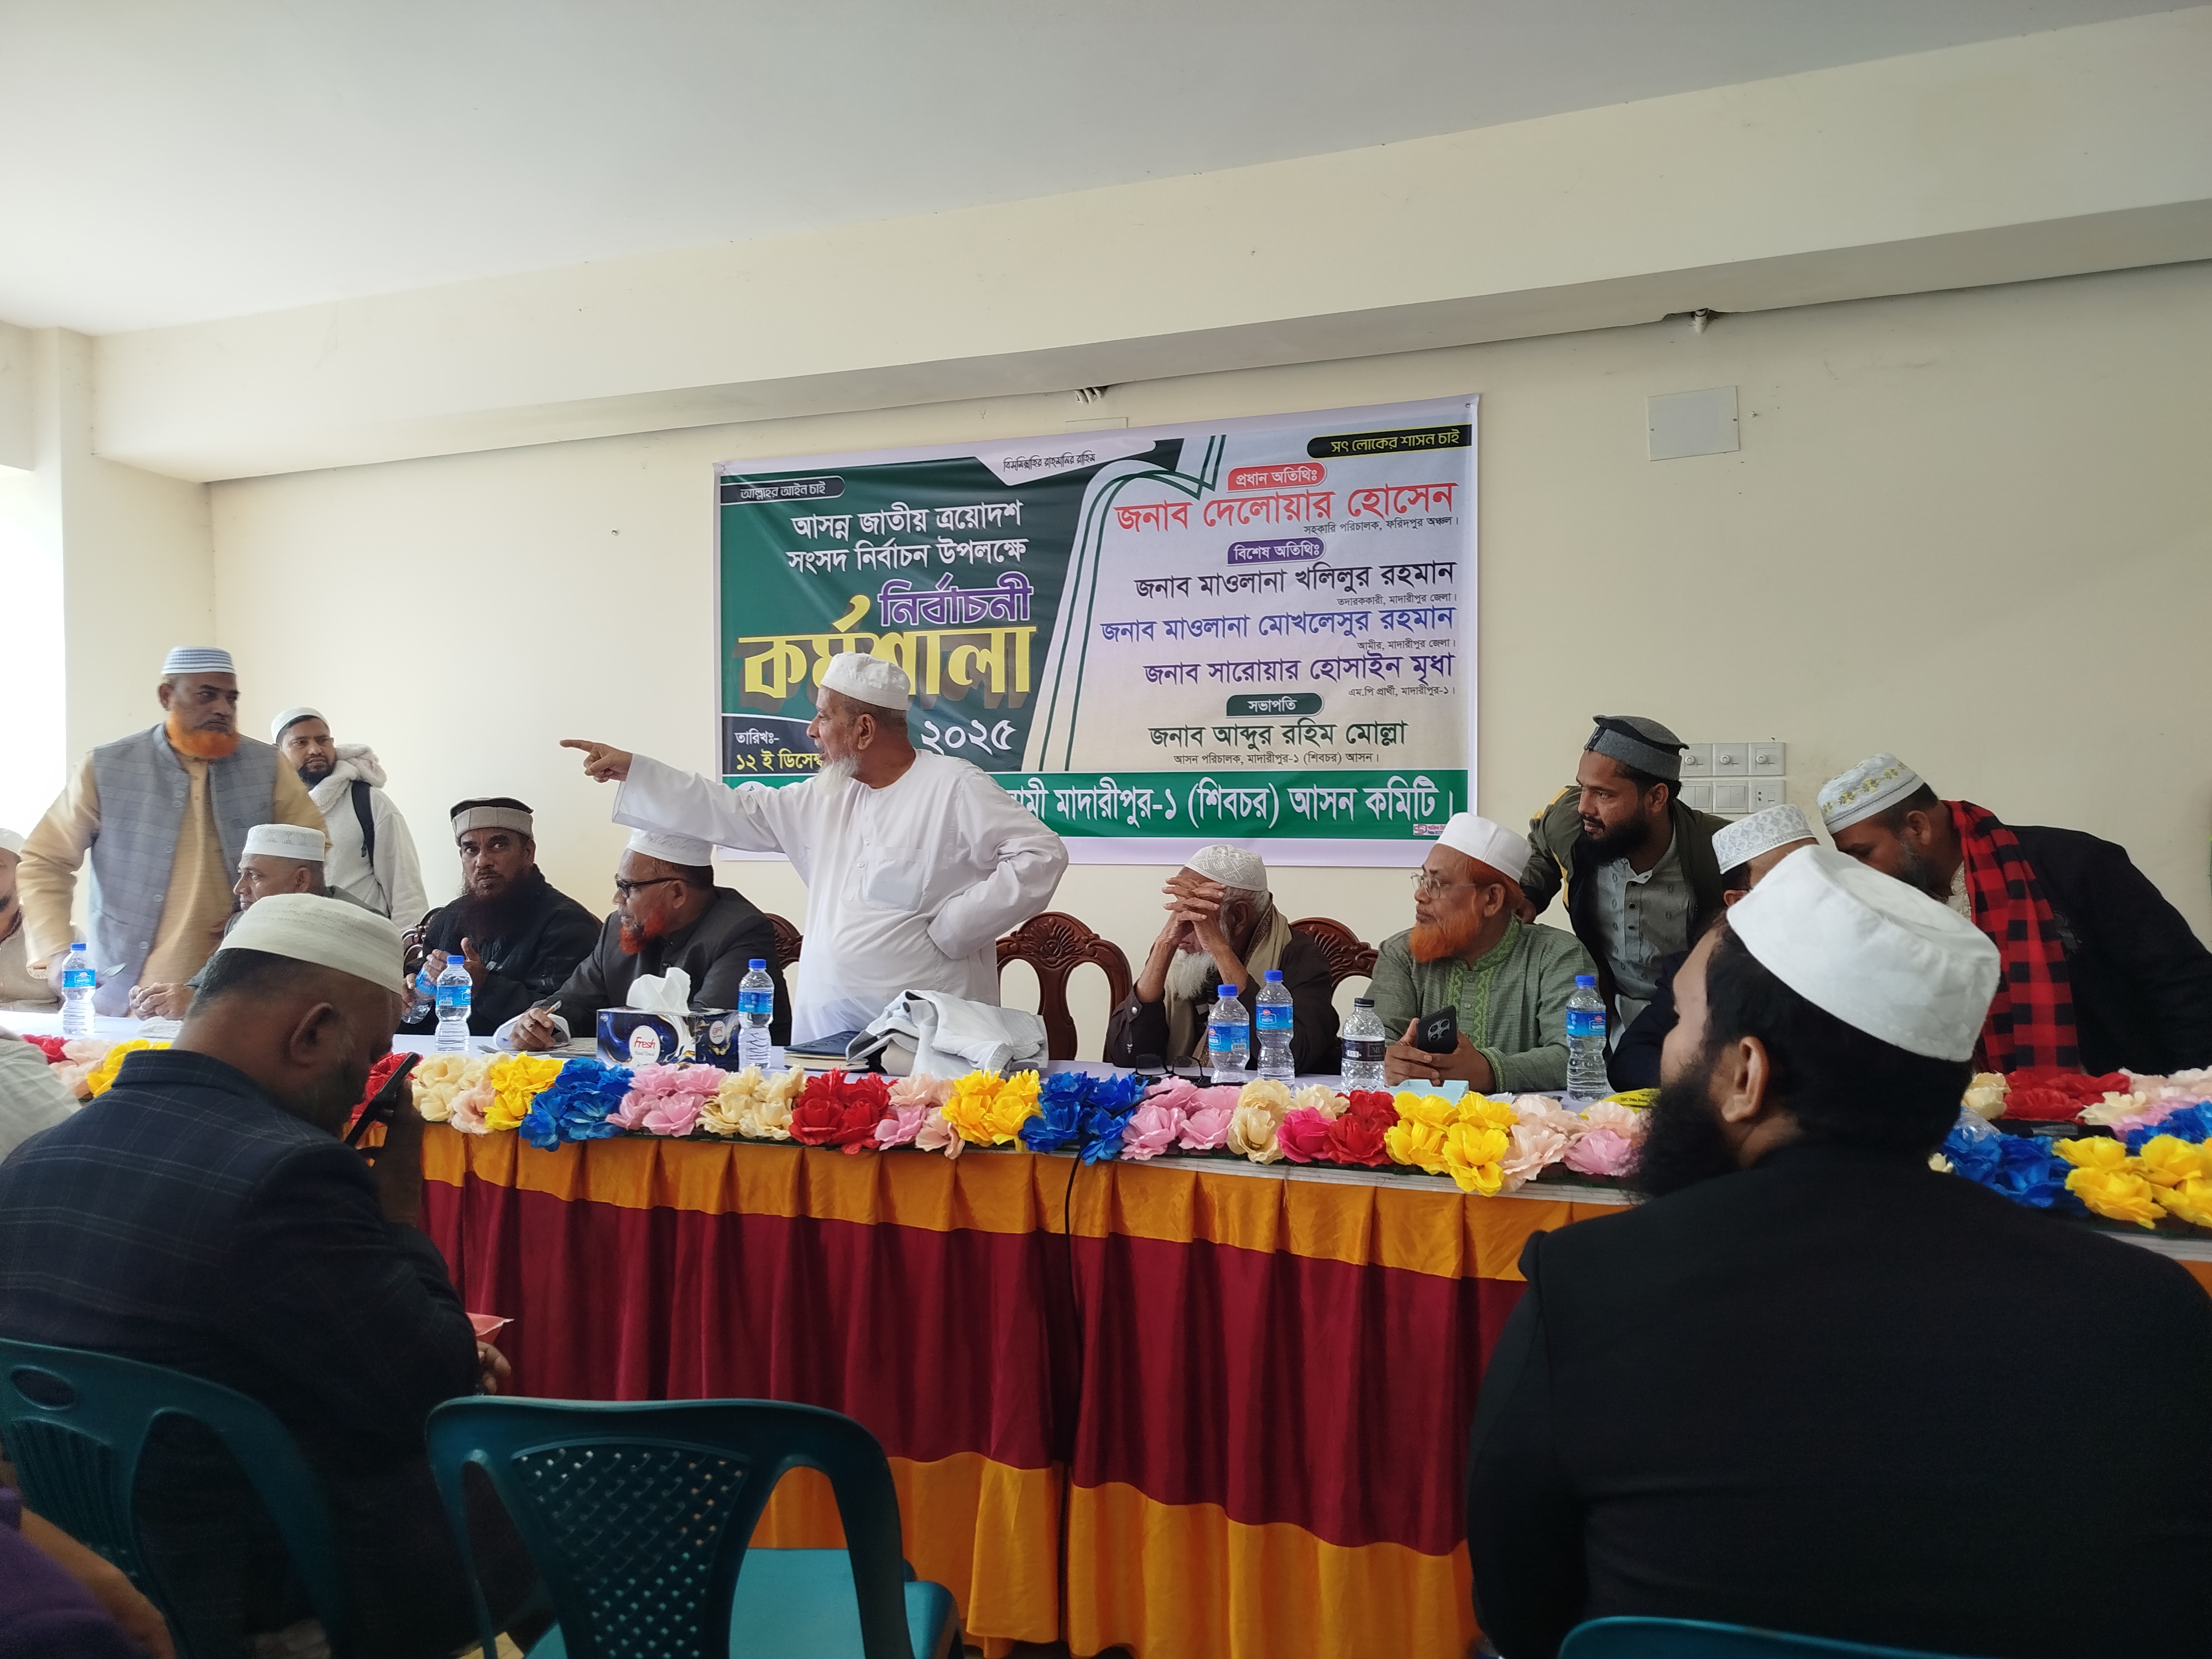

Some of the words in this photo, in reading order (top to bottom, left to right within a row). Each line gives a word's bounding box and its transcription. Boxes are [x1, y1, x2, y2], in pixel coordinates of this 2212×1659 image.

[1331, 440, 1349, 453] সৎ
[1352, 436, 1398, 452] লোকের
[1400, 433, 1436, 447] শাসন
[1438, 429, 1461, 444] চাই
[1075, 450, 1095, 466] রাহিম
[740, 486, 779, 500] আল্লাহর
[780, 482, 807, 497] আইন
[808, 481, 826, 494] চাই
[1235, 471, 1269, 486] প্রধান
[1114, 499, 1192, 533] জনাব
[1203, 489, 1337, 528] দেলোয়ার
[1347, 482, 1459, 520] হোসেন
[790, 513, 854, 542] আসন্ন
[857, 502, 930, 536] জাতীয়
[934, 499, 1025, 530] ত্রয়োদশ
[1303, 523, 1338, 535] সহকারি
[1340, 520, 1382, 533] পরিচালক,
[1386, 517, 1424, 530] ফরিদপুর
[785, 549, 851, 575] সংসদ
[853, 538, 933, 572] নির্বাচন
[936, 536, 1030, 565] উপলক্ষে
[1233, 545, 1271, 560] বিশেষ
[1133, 575, 1193, 599] জনাব
[1197, 568, 1288, 597] মাওলানা
[1295, 561, 1374, 594] খলিলুর
[1379, 559, 1458, 592] রহমান
[877, 571, 1034, 627] নির্বাচনী
[1389, 592, 1427, 605] মাদারীপুর
[1099, 619, 1158, 643] জনাব
[1162, 614, 1251, 641] মাওলানা
[1259, 611, 1373, 639] মোখলেসুর
[1378, 605, 1458, 634] রহমান
[1357, 639, 1385, 651] আমীর,
[1387, 637, 1427, 650] মাদারীপুর
[1142, 661, 1202, 685] জনাব
[1206, 658, 1303, 684] সারোয়ার
[1310, 650, 1405, 684] হোসাইন
[1408, 651, 1456, 686] মৃধা
[1348, 685, 1375, 697] এম.পি
[1247, 696, 1297, 713] সভাপতি
[921, 719, 1017, 755] ২০২৫
[1147, 724, 1207, 748] জনাব
[1211, 722, 1276, 752] আব্দুর
[1280, 717, 1338, 749] রহিম
[1346, 719, 1409, 748] মোল্লা
[737, 754, 758, 772] ১২
[760, 748, 775, 772] ই
[777, 748, 823, 770] ডিসেম্ব
[1173, 754, 1199, 764] আসন
[1202, 752, 1244, 765] পরিচালক,
[1247, 750, 1299, 766] মাদারীপুর-১
[1303, 750, 1342, 766] (শিবচর)
[1052, 776, 1177, 829] মাদারীপুর-১
[1188, 776, 1280, 830] (শিবচর)
[1287, 783, 1359, 822] আসন
[634, 1036, 655, 1049] Fresh
